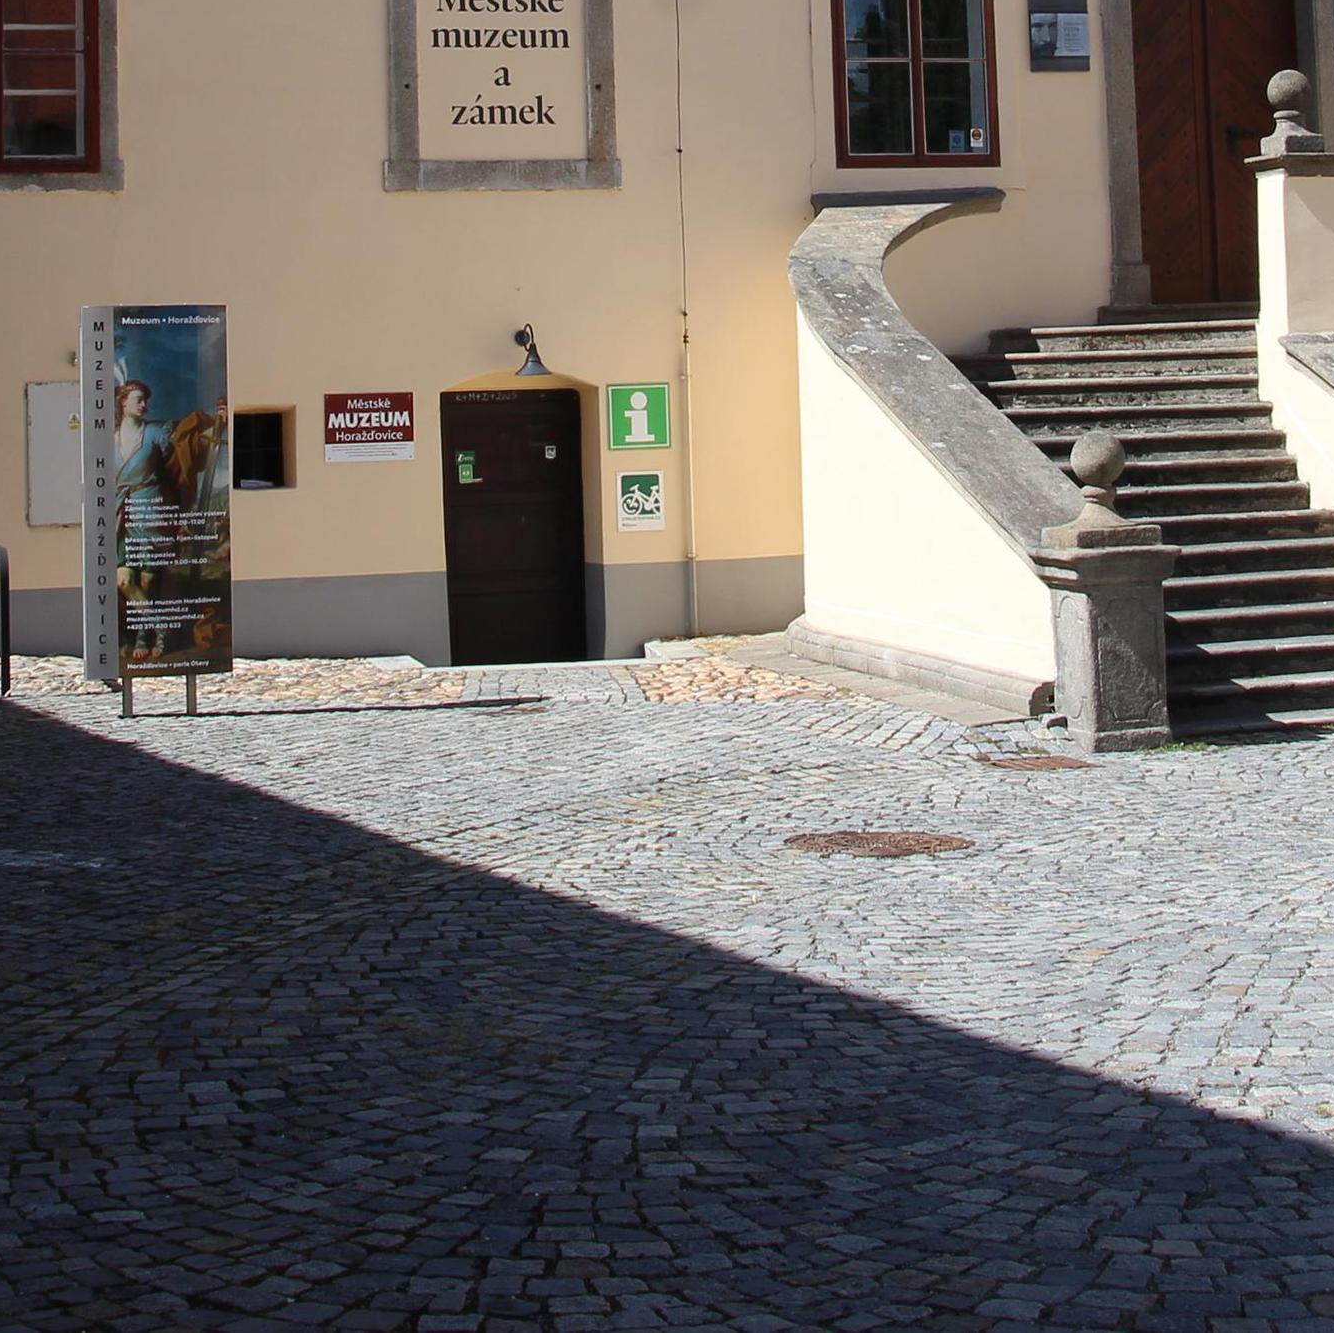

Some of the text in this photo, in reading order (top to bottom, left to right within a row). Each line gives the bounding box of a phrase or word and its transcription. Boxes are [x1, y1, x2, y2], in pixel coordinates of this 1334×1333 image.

[431, 28, 570, 49] muzeum
[494, 66, 511, 87] a
[451, 94, 556, 126] zámek
[121, 315, 220, 325] Muzeum Horažďovice
[347, 397, 391, 409] Městské
[328, 411, 411, 429] MUZEUM
[335, 429, 404, 442] Horažďovice
[93, 321, 107, 665] MUZEUM HORAŽĎOVICE
